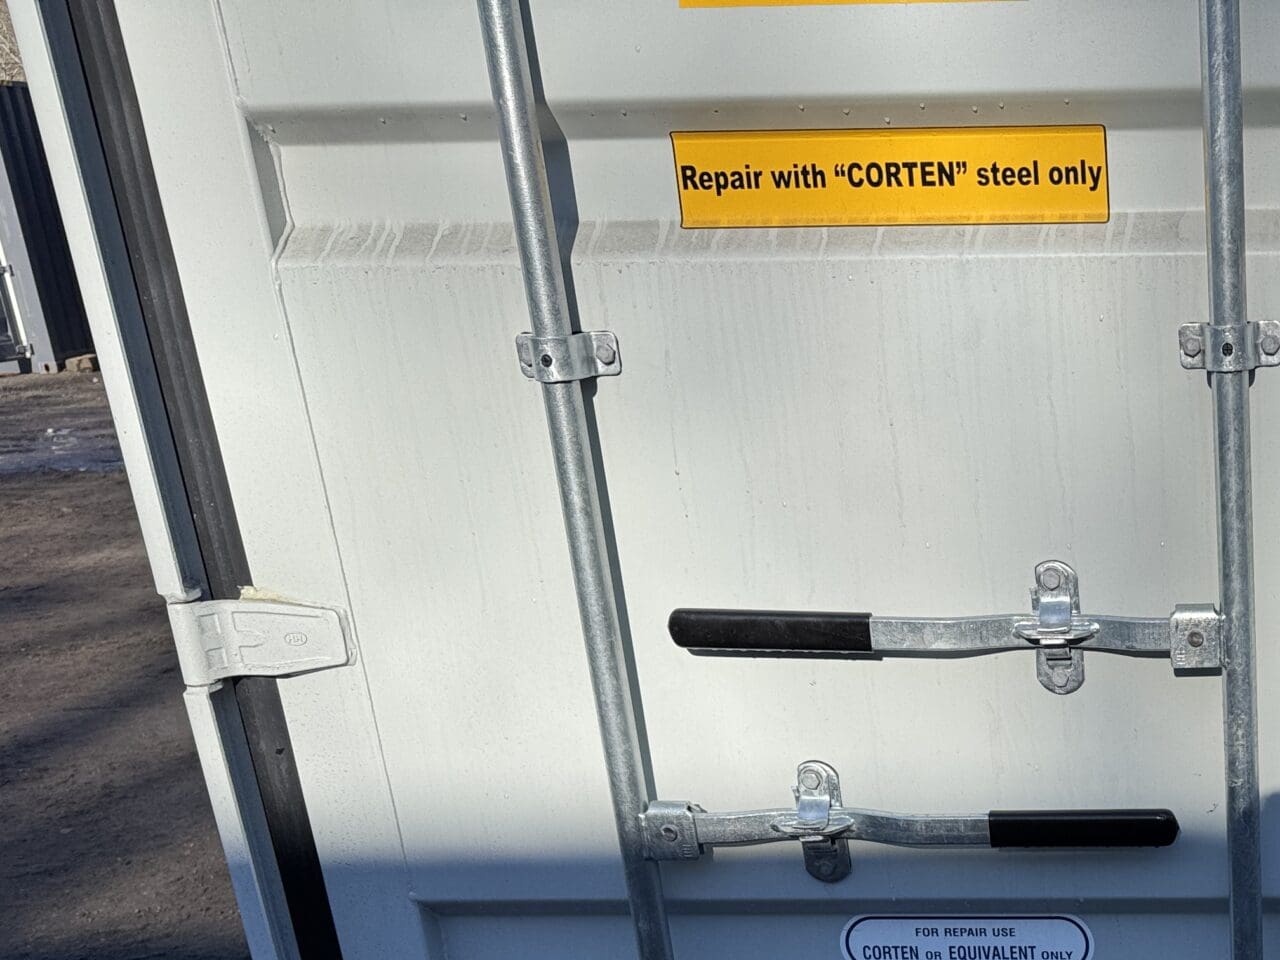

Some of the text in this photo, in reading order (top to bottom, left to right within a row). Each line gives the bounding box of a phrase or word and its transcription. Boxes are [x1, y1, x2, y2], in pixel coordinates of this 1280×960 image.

[680, 159, 1102, 196] Repair with “CORTEN” steel only
[915, 927, 1016, 937] FOR REPAIR USE
[862, 945, 1073, 960] CORTEN OR EQUIVALENT ONLY
